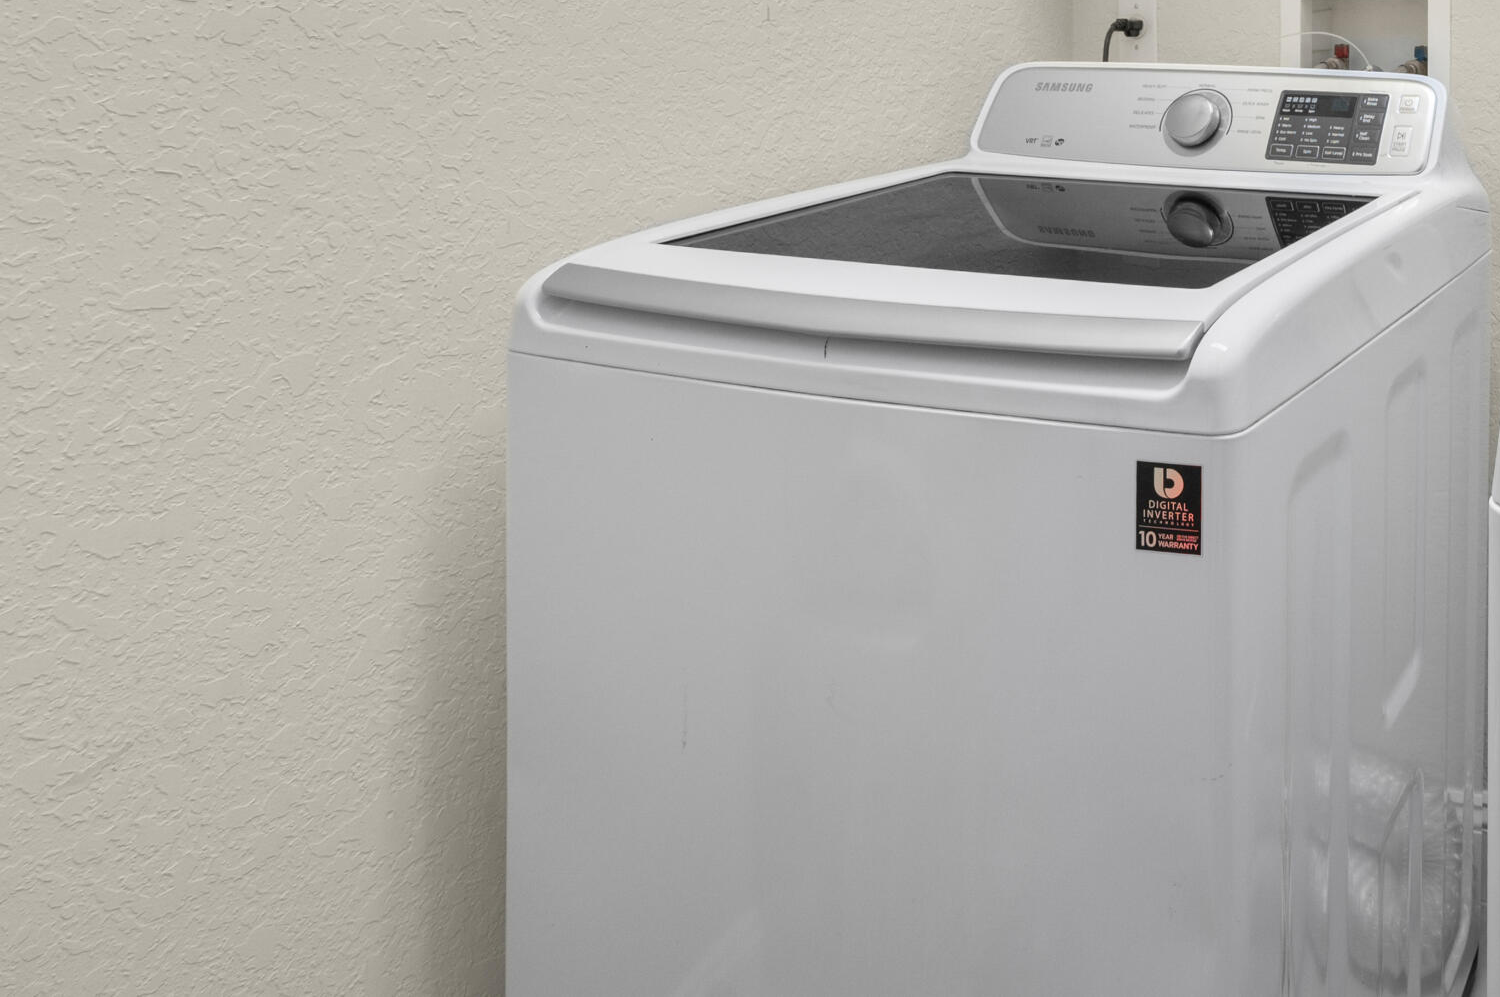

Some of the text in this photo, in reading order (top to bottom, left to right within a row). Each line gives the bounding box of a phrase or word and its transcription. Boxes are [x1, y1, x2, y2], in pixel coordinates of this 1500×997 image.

[1034, 82, 1094, 93] SAMSUNG
[1148, 499, 1189, 512] DIGITAL
[1143, 509, 1194, 522] INVERTER
[1139, 530, 1156, 548] 10
[1158, 540, 1199, 550] WARRANTY
